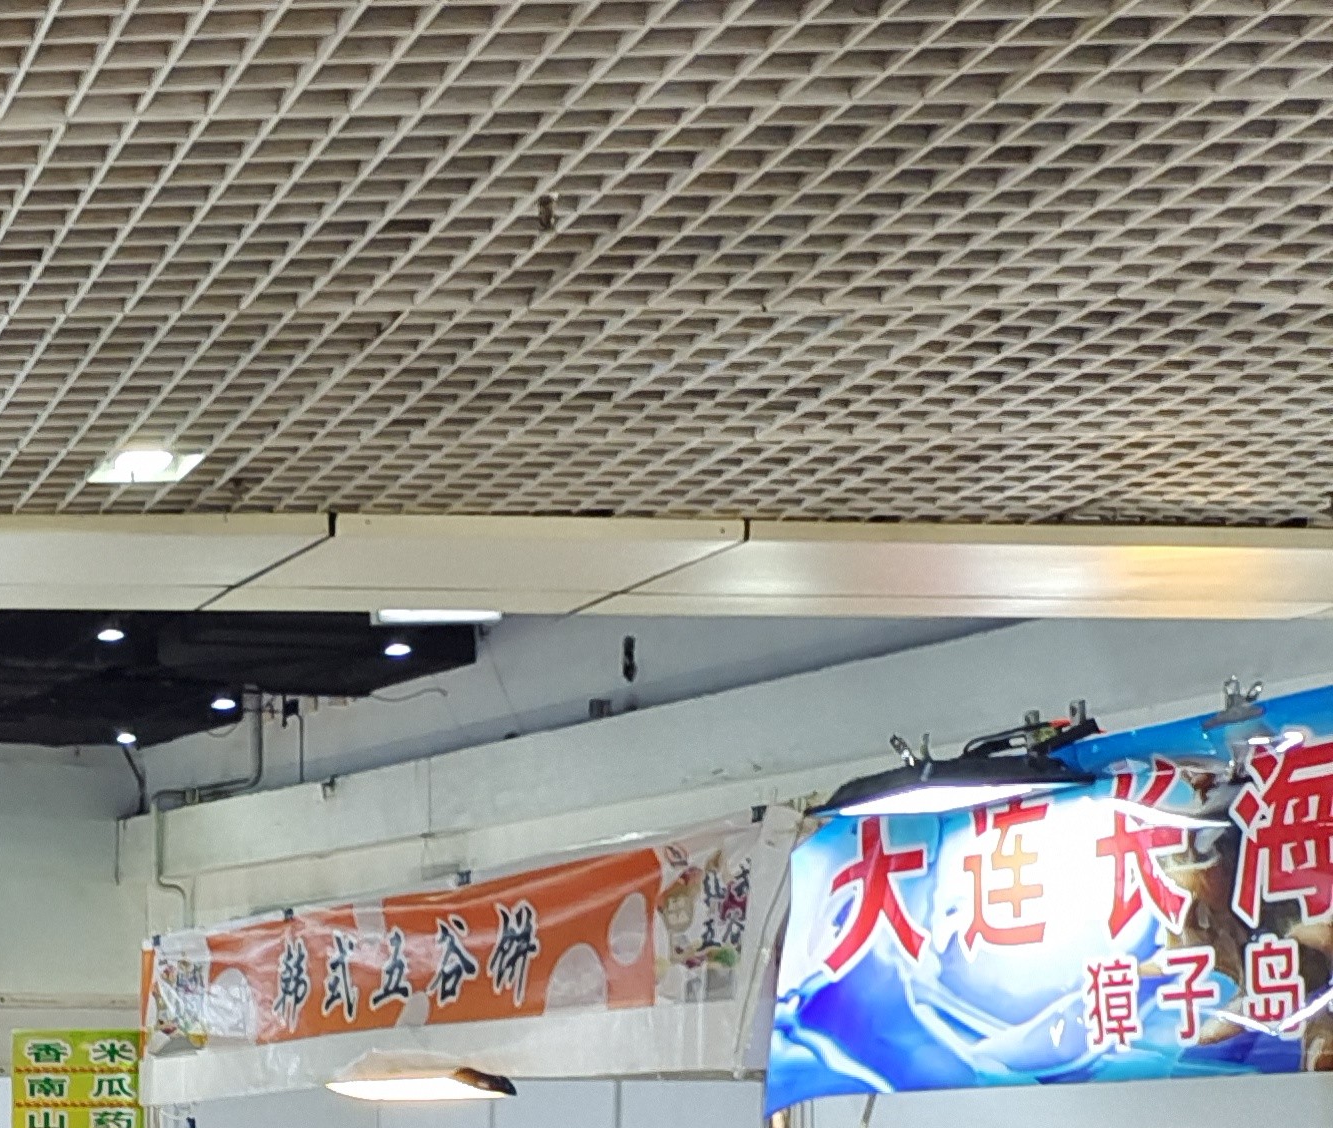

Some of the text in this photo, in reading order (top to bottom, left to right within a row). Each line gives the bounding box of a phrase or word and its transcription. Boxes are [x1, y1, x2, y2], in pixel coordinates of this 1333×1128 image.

[823, 738, 1333, 975] 大连长海
[274, 903, 538, 1029] 韩式五谷饼
[1087, 945, 1301, 1046] 獐子岛
[27, 1041, 134, 1064] 香米
[27, 1076, 134, 1097] 南瓜
